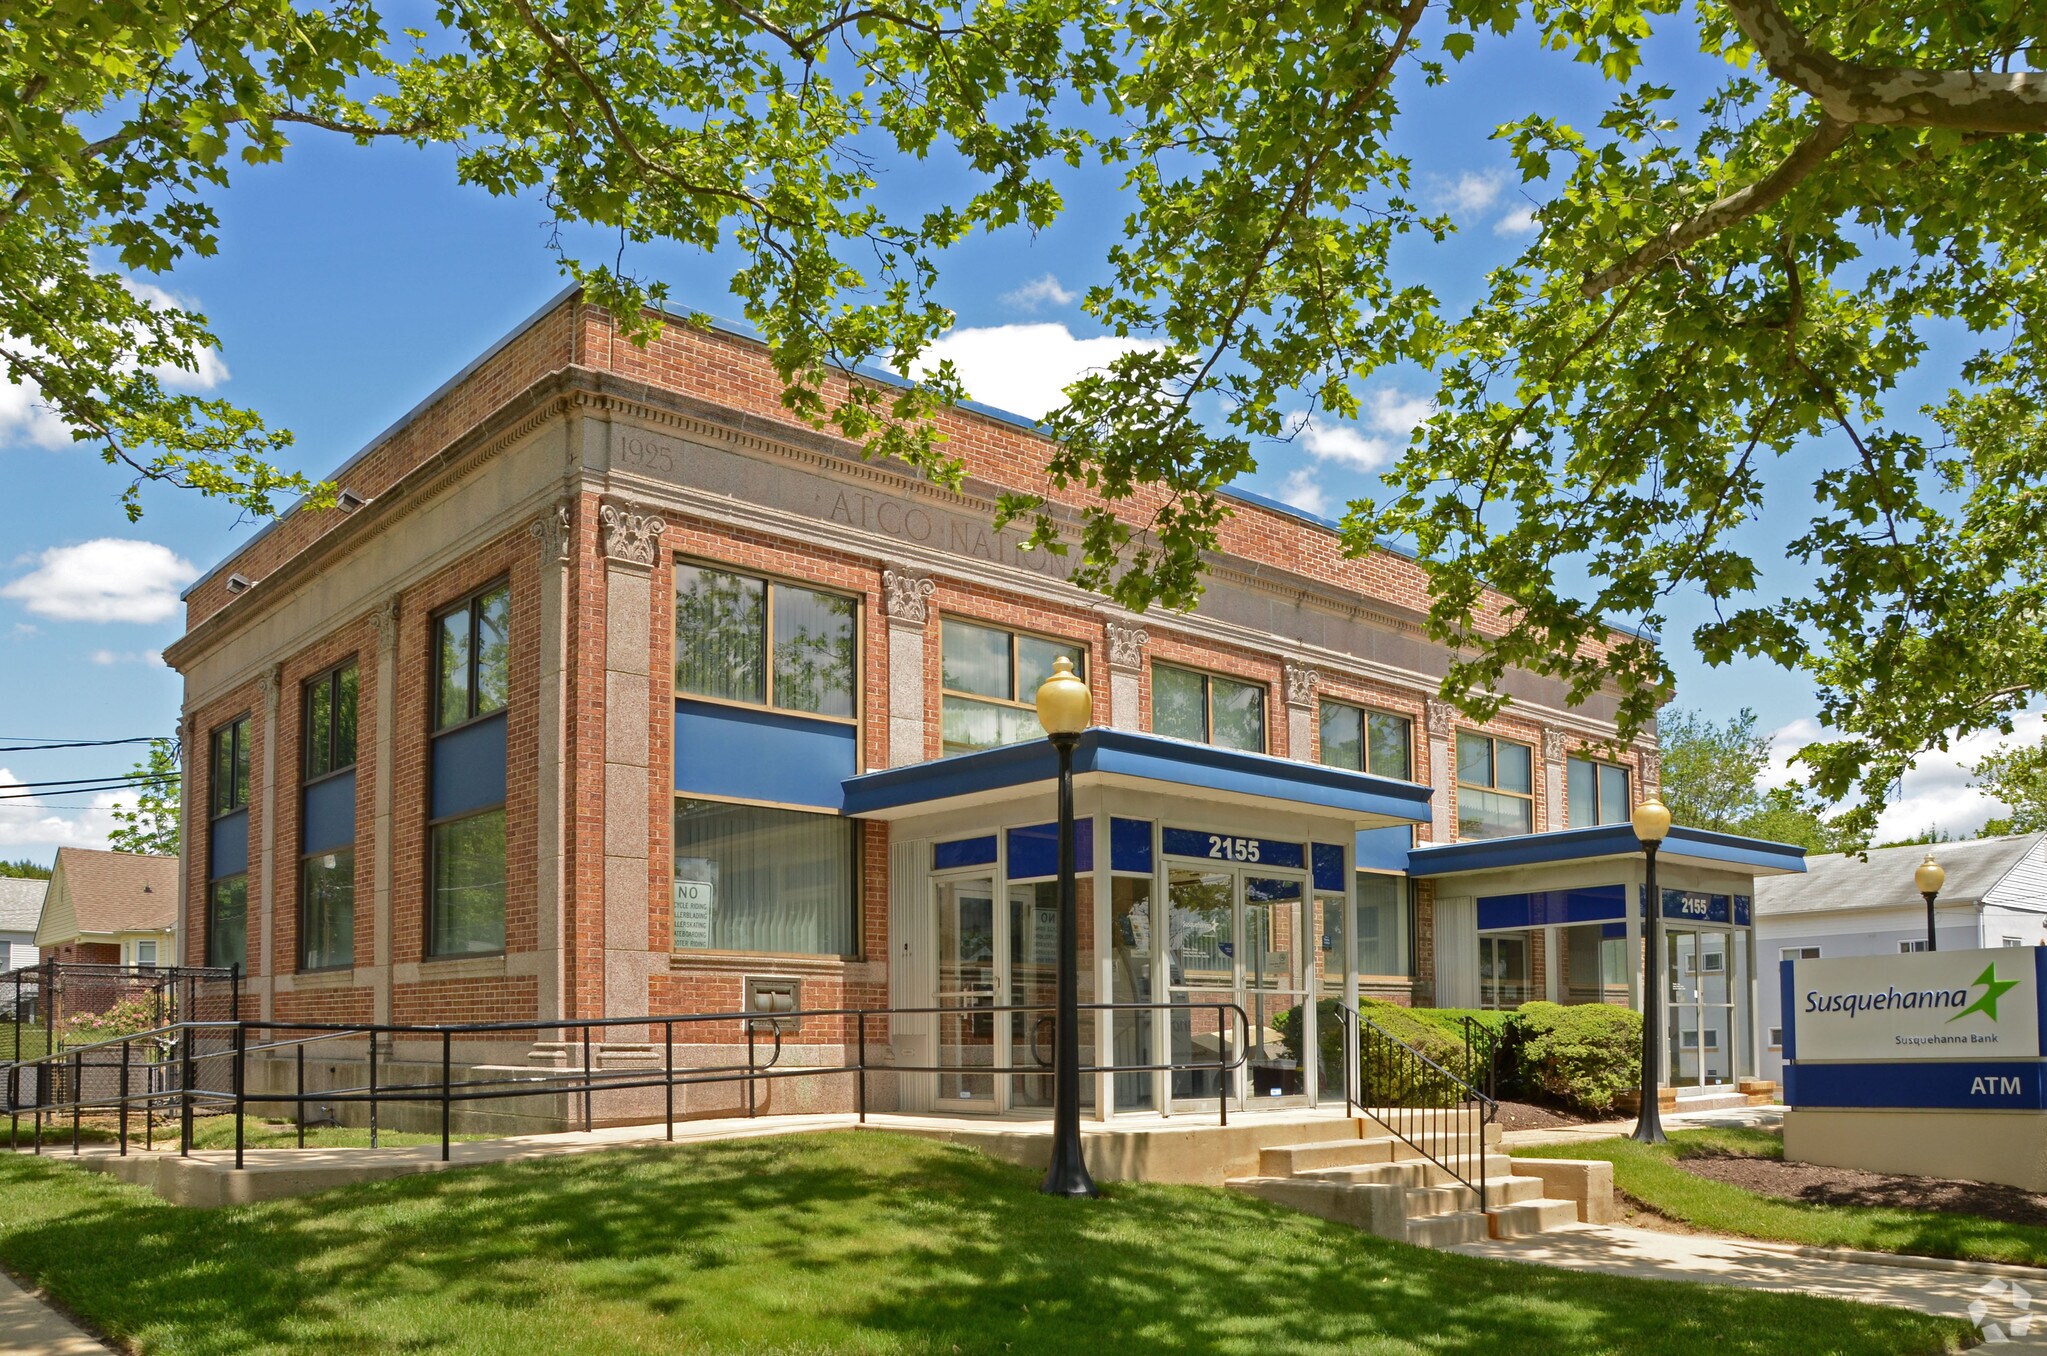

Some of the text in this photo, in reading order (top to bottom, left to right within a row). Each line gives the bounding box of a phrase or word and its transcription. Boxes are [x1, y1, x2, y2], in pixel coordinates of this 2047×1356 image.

[621, 437, 673, 473] 1925
[830, 489, 1092, 583] ATCO NATIONA
[1209, 836, 1260, 862] 2155
[678, 886, 698, 899] NO
[1681, 897, 1707, 914] 2155
[1805, 986, 1967, 1018] Susquehanna
[1895, 1033, 1999, 1046] Susquehanna Bank
[1970, 1076, 2021, 1095] ATM
